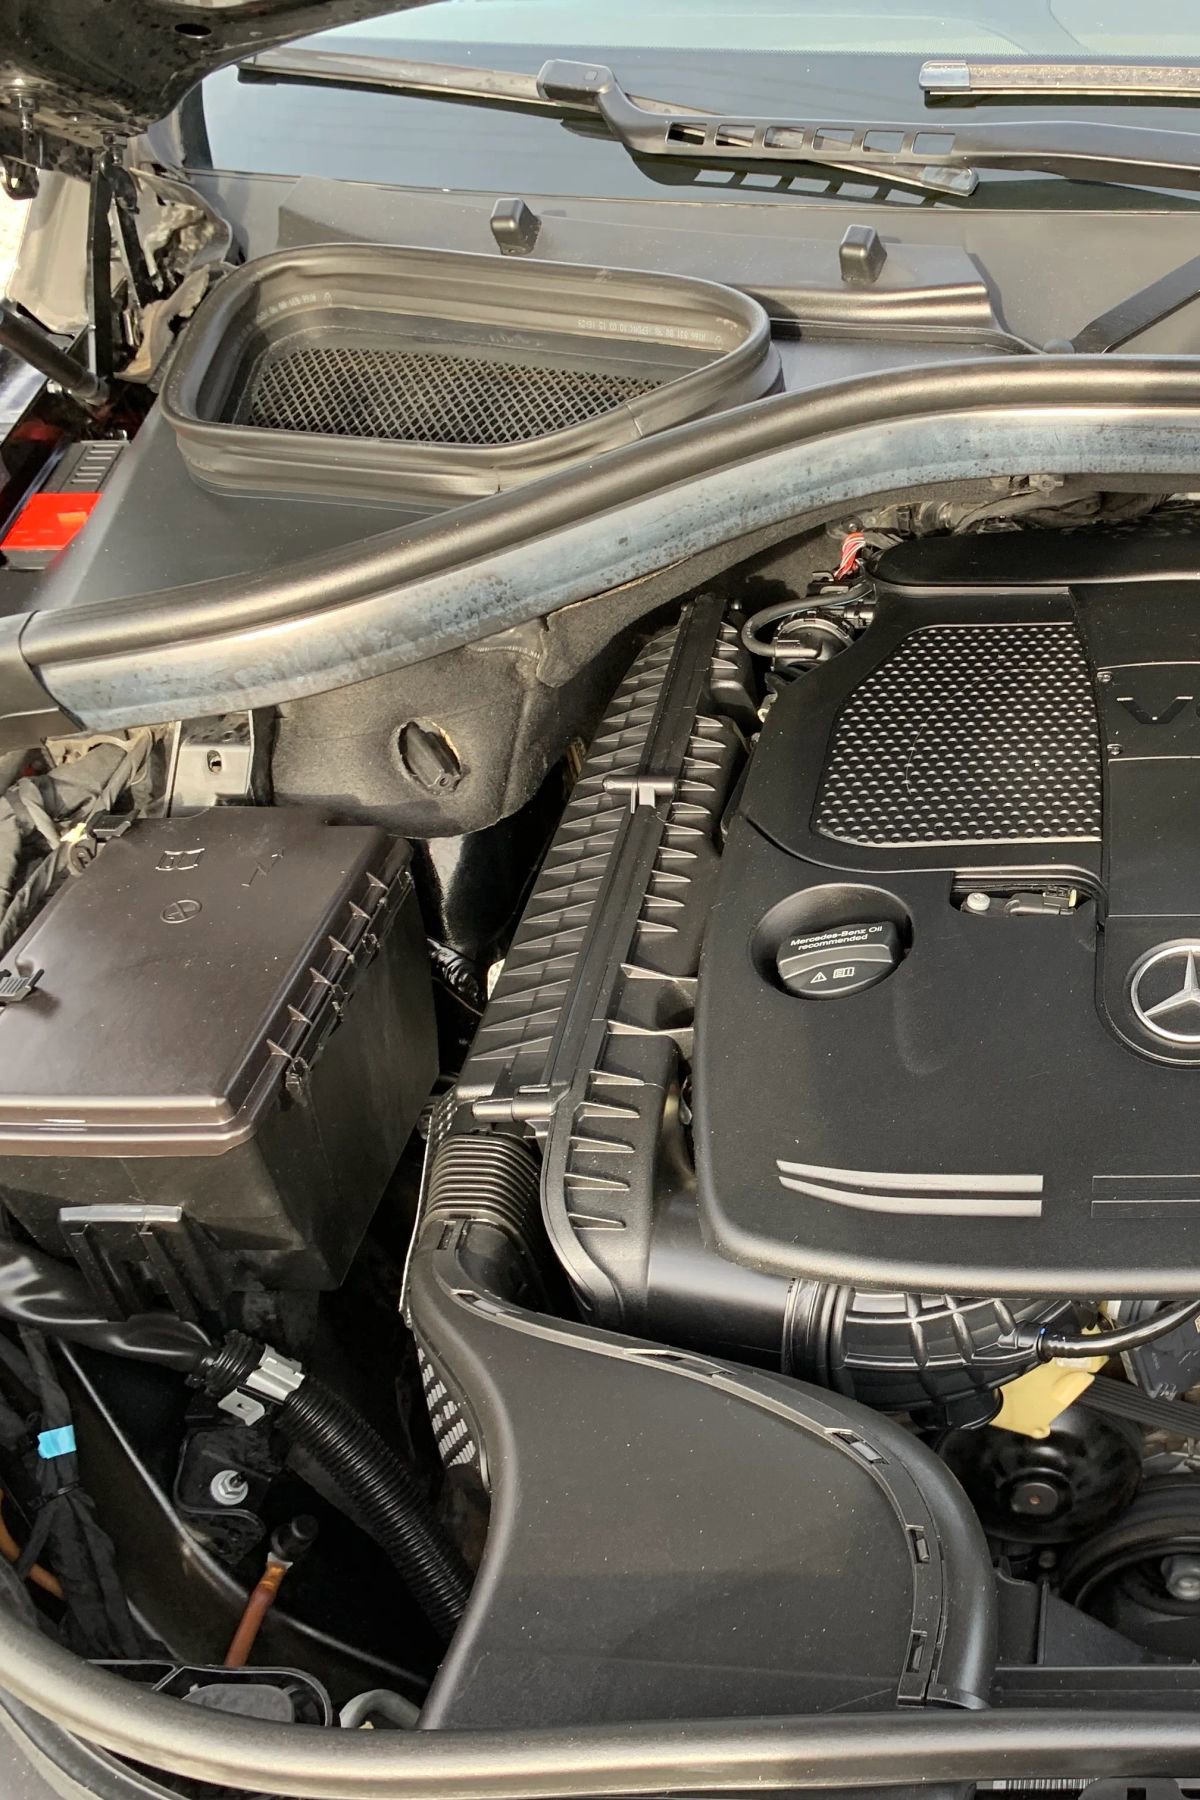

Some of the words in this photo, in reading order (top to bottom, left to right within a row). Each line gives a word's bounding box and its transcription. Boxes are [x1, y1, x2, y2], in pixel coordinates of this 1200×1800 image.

[790, 927, 867, 946] Mercedes-Benz
[868, 925, 883, 933] Oil
[797, 935, 868, 950] recommended
